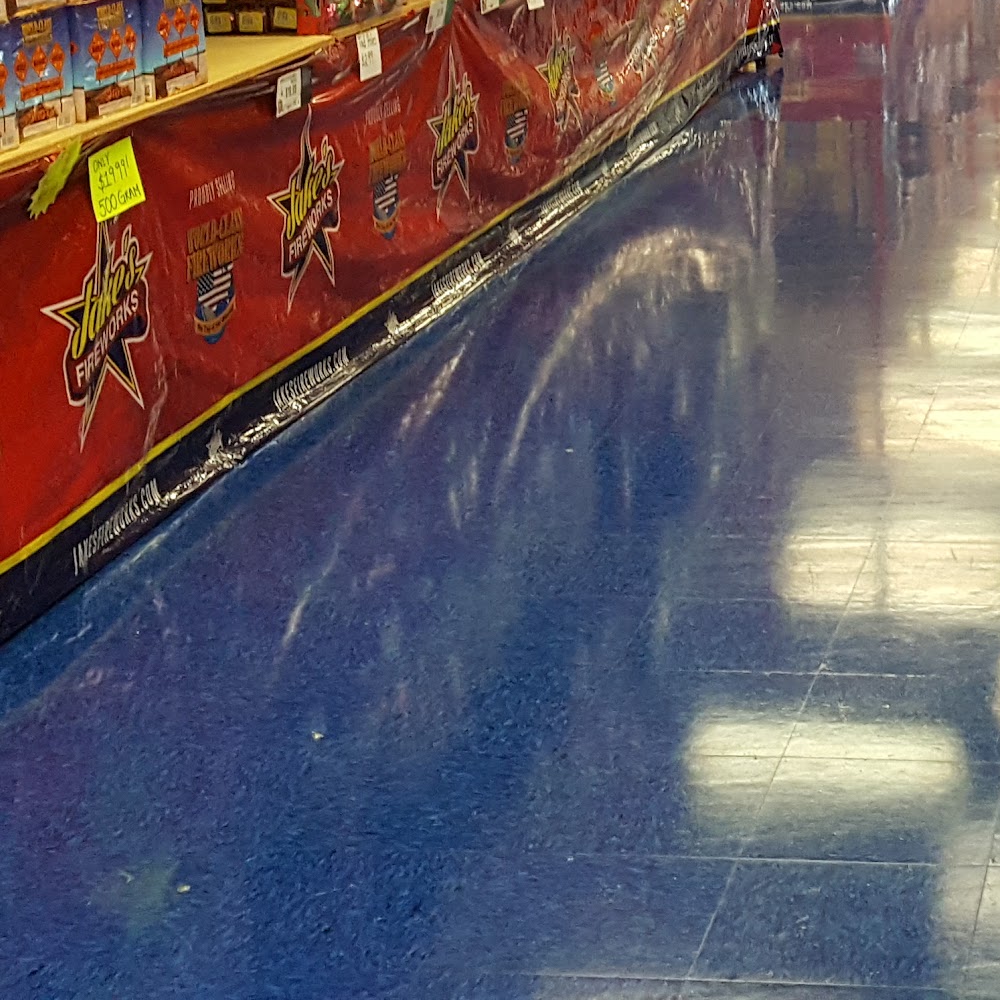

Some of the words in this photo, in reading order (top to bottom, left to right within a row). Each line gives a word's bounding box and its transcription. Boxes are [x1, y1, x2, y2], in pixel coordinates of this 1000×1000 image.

[93, 153, 110, 173] ONLY
[288, 188, 333, 263] FIREWORKS
[75, 289, 139, 388] FIREWORKS
